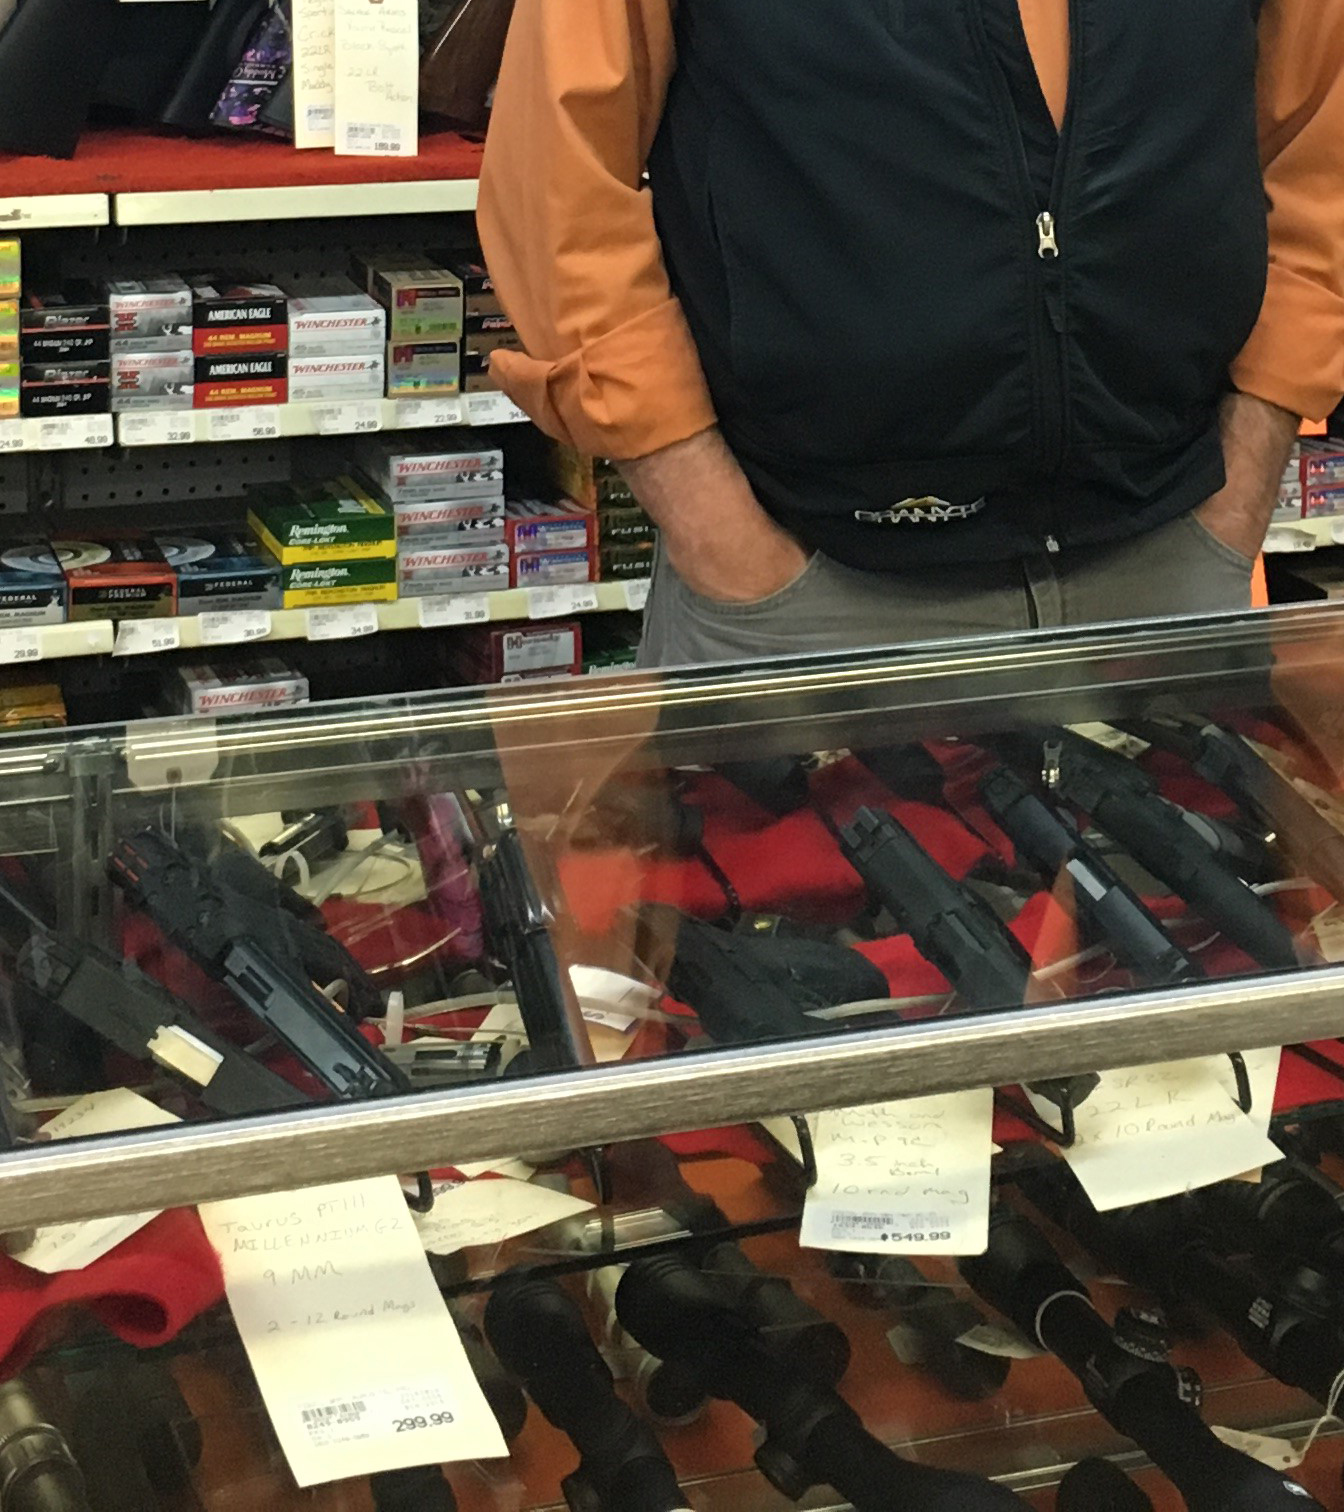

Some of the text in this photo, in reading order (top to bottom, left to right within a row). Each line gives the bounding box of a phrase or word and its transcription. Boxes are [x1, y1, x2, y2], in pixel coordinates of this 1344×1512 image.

[208, 306, 272, 322] AMERICAN EAGLE
[294, 317, 367, 330] WINCHESTER
[209, 360, 273, 376] AMERICAN EAGLE
[293, 360, 366, 373] WINCHESTER
[397, 456, 482, 474] WINCHESTER
[397, 506, 483, 523] WINCHESTER
[289, 523, 349, 539] Remington
[401, 552, 489, 569] WINCHESTER
[289, 567, 349, 582] Remington
[221, 1211, 303, 1235] Taurus
[233, 1224, 370, 1253] MILLENNIUM
[262, 1260, 343, 1287] 9 MM
[334, 1304, 375, 1321] Round
[391, 1410, 455, 1434] 299.99
